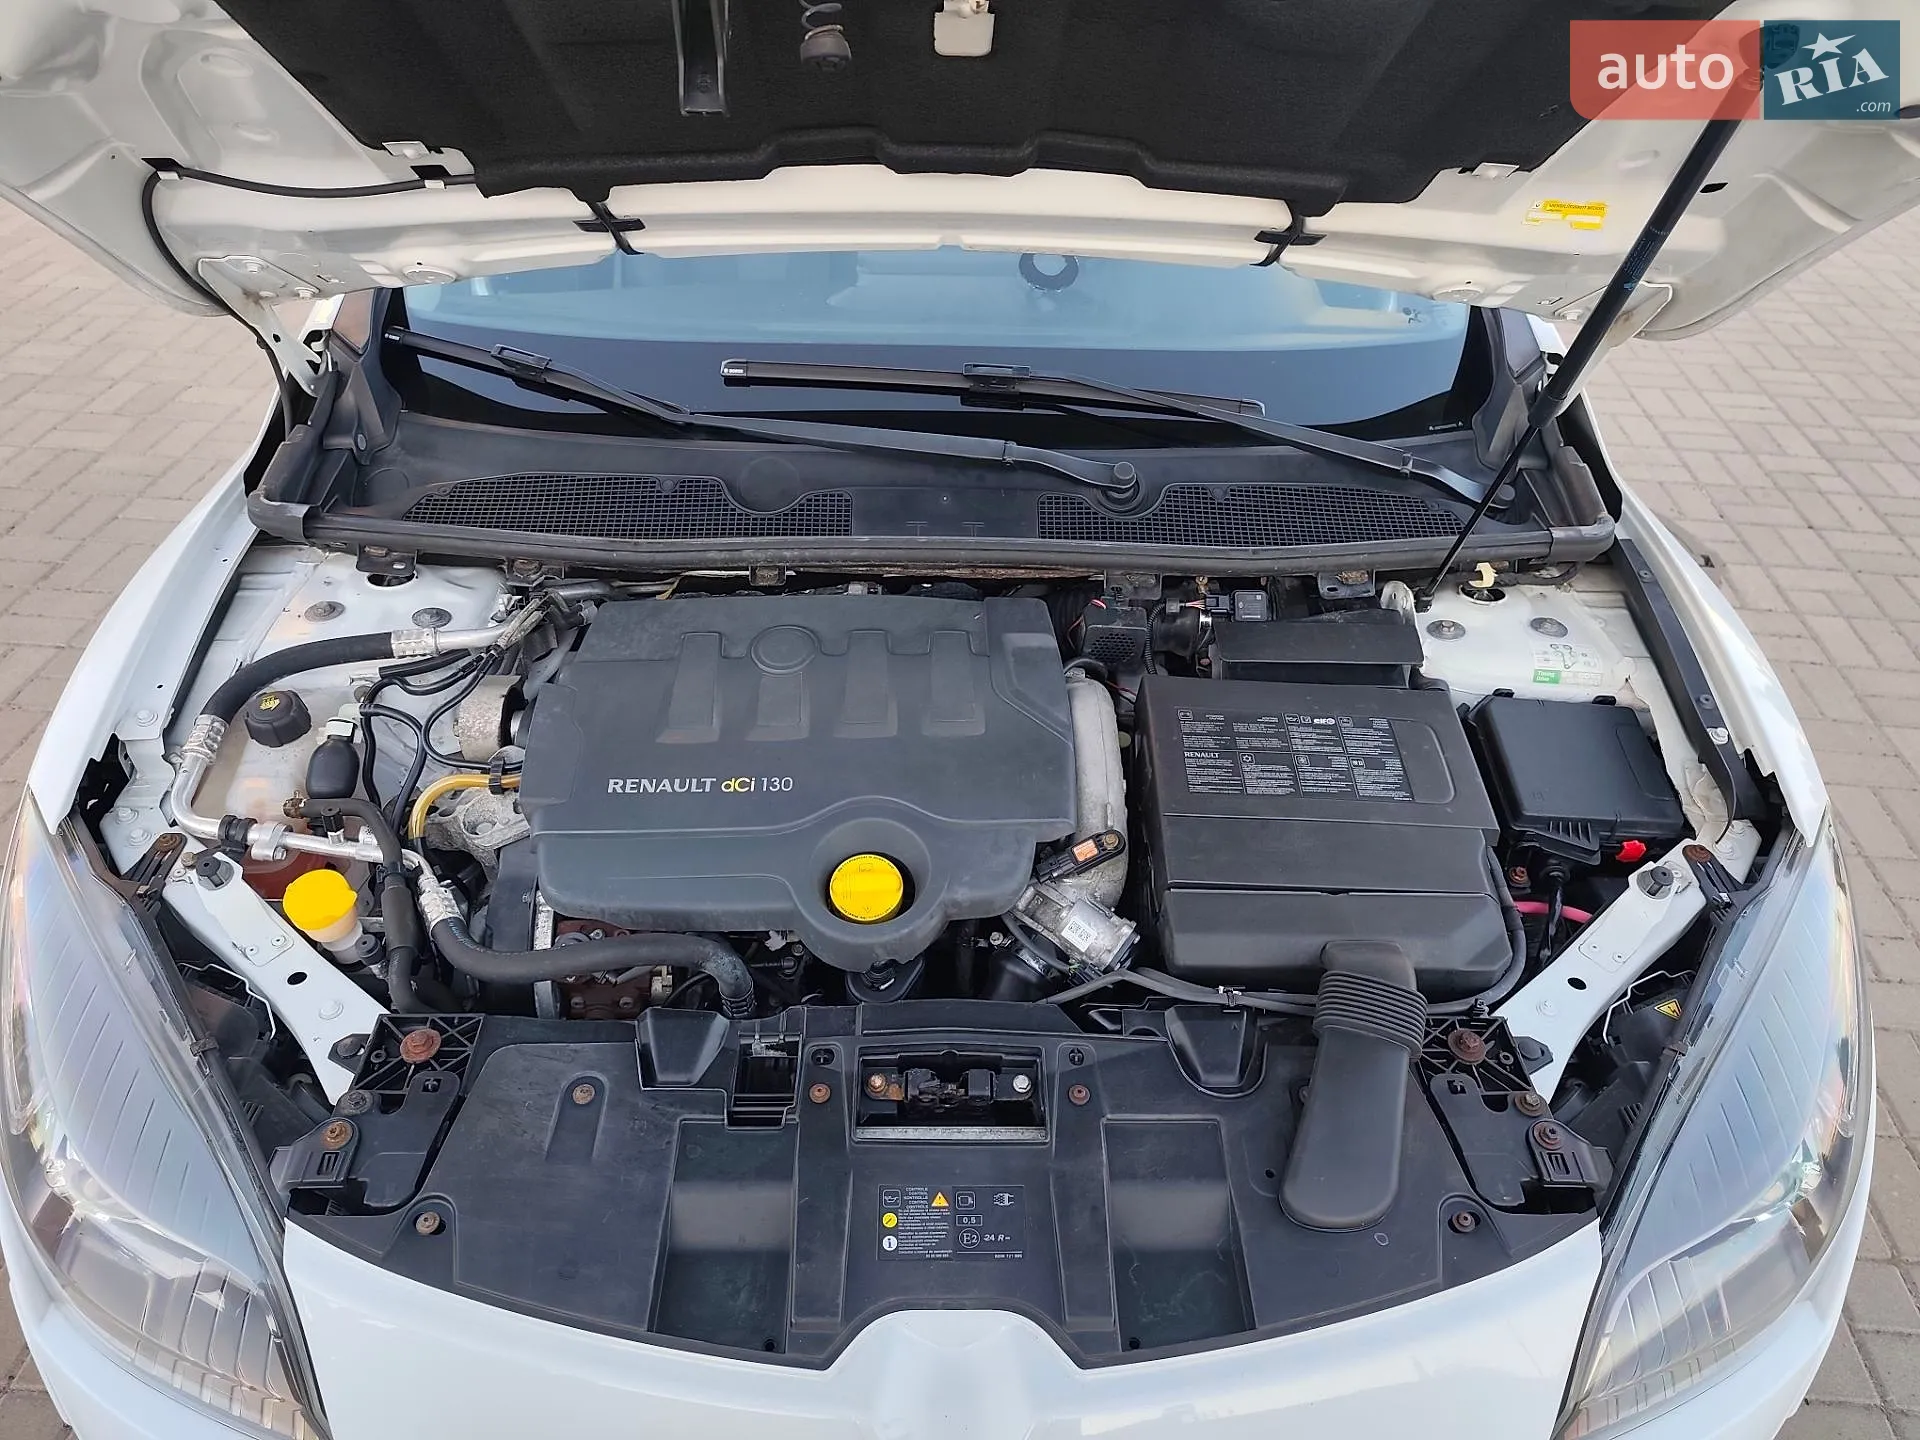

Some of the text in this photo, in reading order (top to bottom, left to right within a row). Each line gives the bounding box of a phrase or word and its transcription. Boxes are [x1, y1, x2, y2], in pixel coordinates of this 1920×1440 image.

[1184, 751, 1220, 759] RENAULT
[607, 776, 793, 793] RENAULT dCi 130
[962, 1216, 976, 1224] 0,5
[962, 1232, 978, 1244] E2
